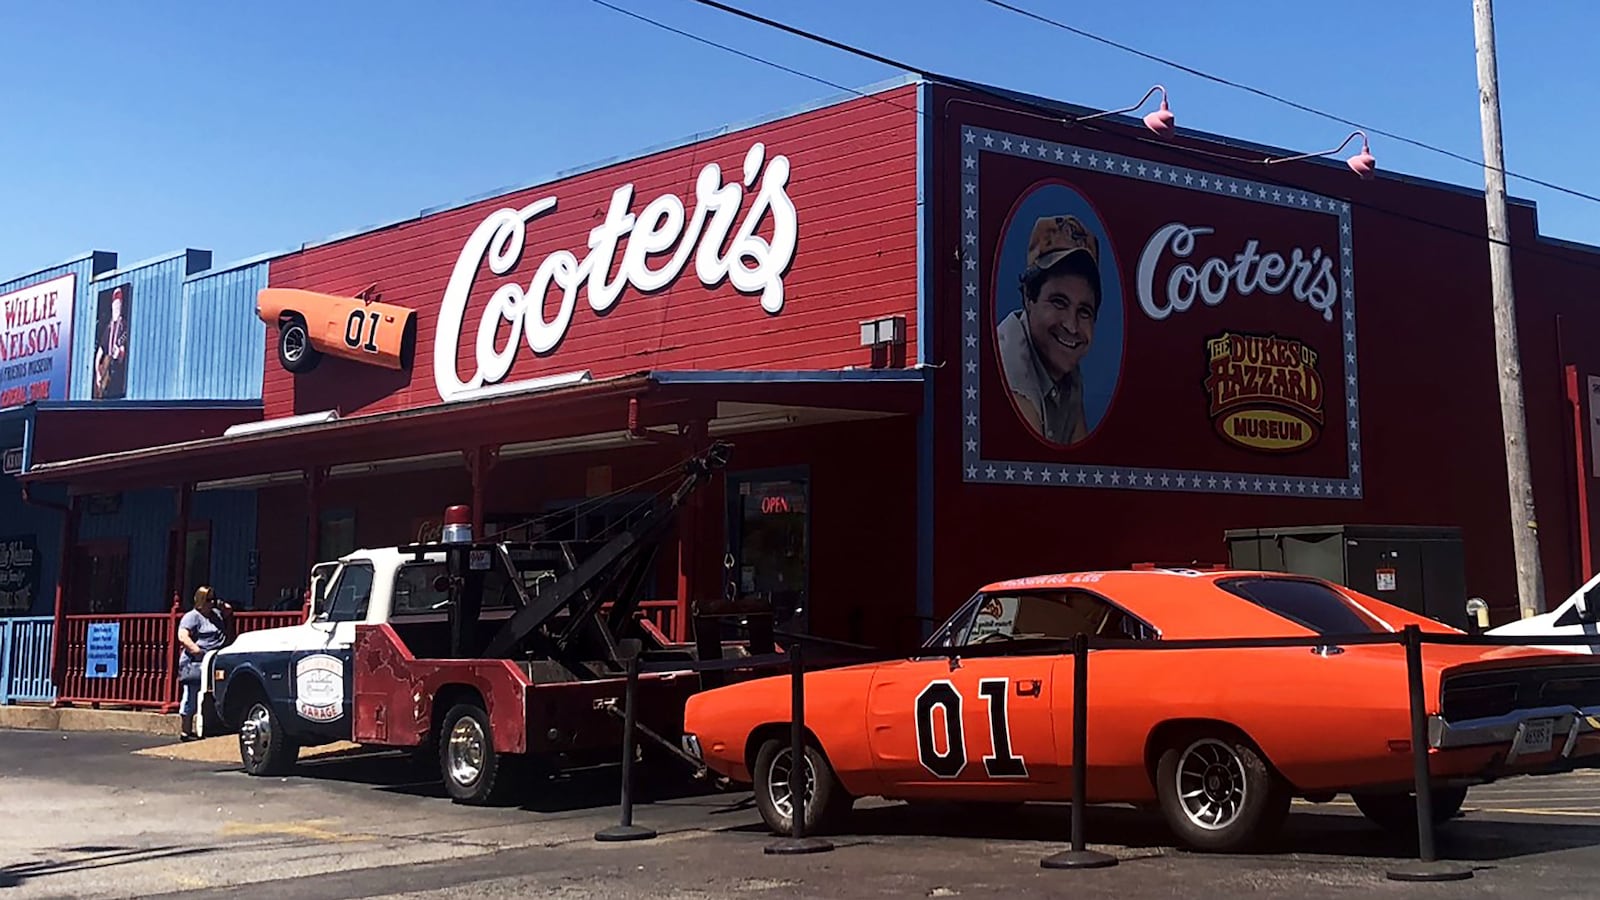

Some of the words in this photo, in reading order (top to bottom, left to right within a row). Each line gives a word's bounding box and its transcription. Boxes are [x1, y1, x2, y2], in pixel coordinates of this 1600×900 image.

[433, 142, 799, 402] Cooter's
[1136, 222, 1339, 321] Cooter's
[4, 290, 59, 330] WILLIE
[343, 308, 381, 354] 01
[1207, 333, 1231, 359] THE
[1230, 333, 1301, 369] DUKES
[1301, 345, 1318, 366] OF
[1204, 356, 1323, 417] HAZZARD
[1233, 417, 1303, 441] MUSEUM
[761, 497, 790, 513] OPEN
[301, 703, 338, 718] GARAGE
[914, 677, 1029, 778] 01
